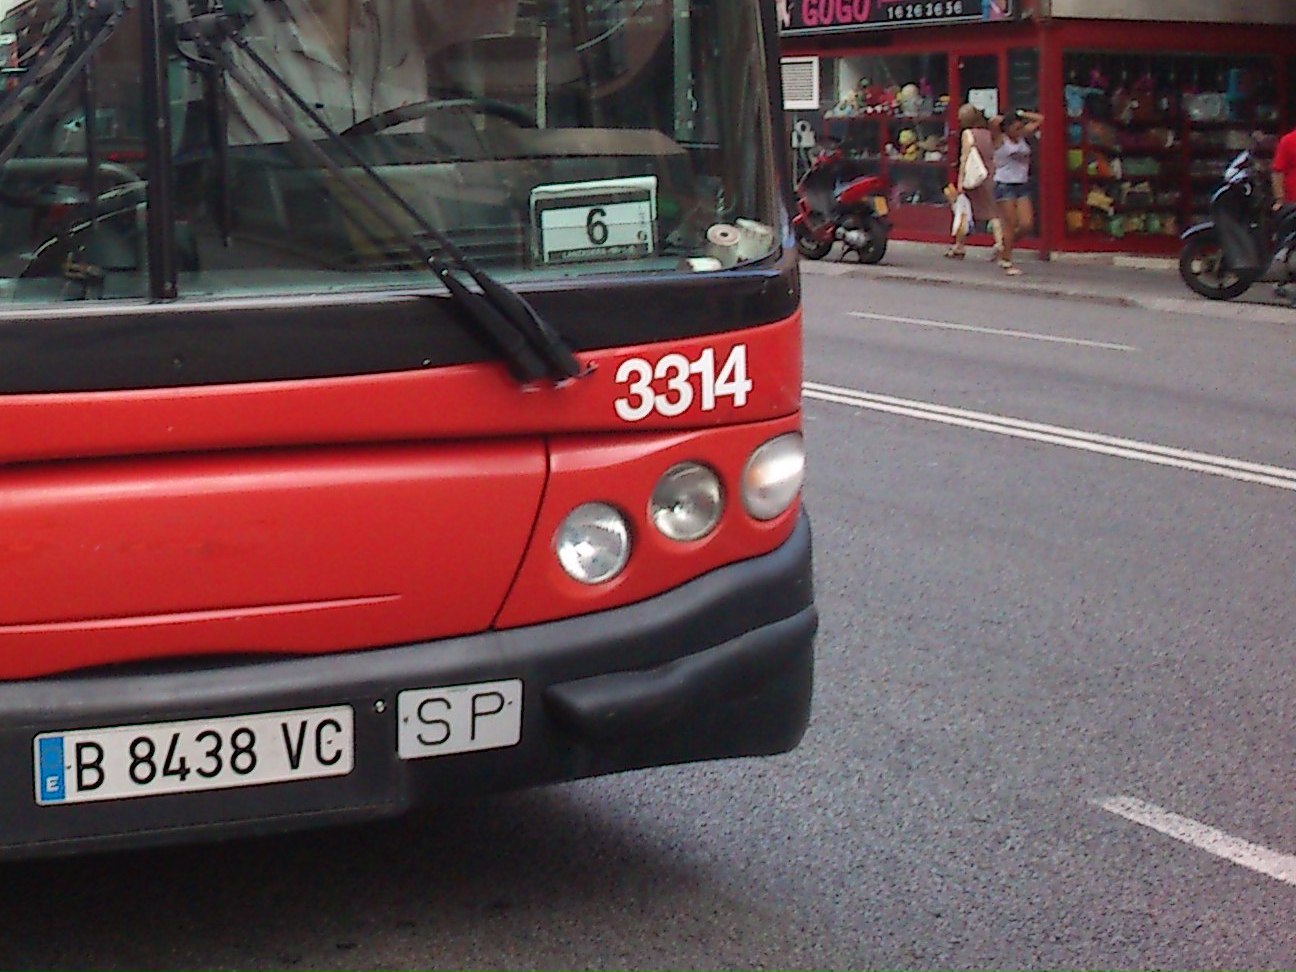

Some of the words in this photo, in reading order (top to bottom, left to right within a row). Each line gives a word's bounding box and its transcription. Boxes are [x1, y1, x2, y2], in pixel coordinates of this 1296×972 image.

[586, 207, 609, 245] 6
[614, 344, 753, 423] 3314
[46, 777, 60, 793] E
[74, 741, 105, 793] B
[128, 726, 258, 786] 8438
[280, 718, 343, 772] VC
